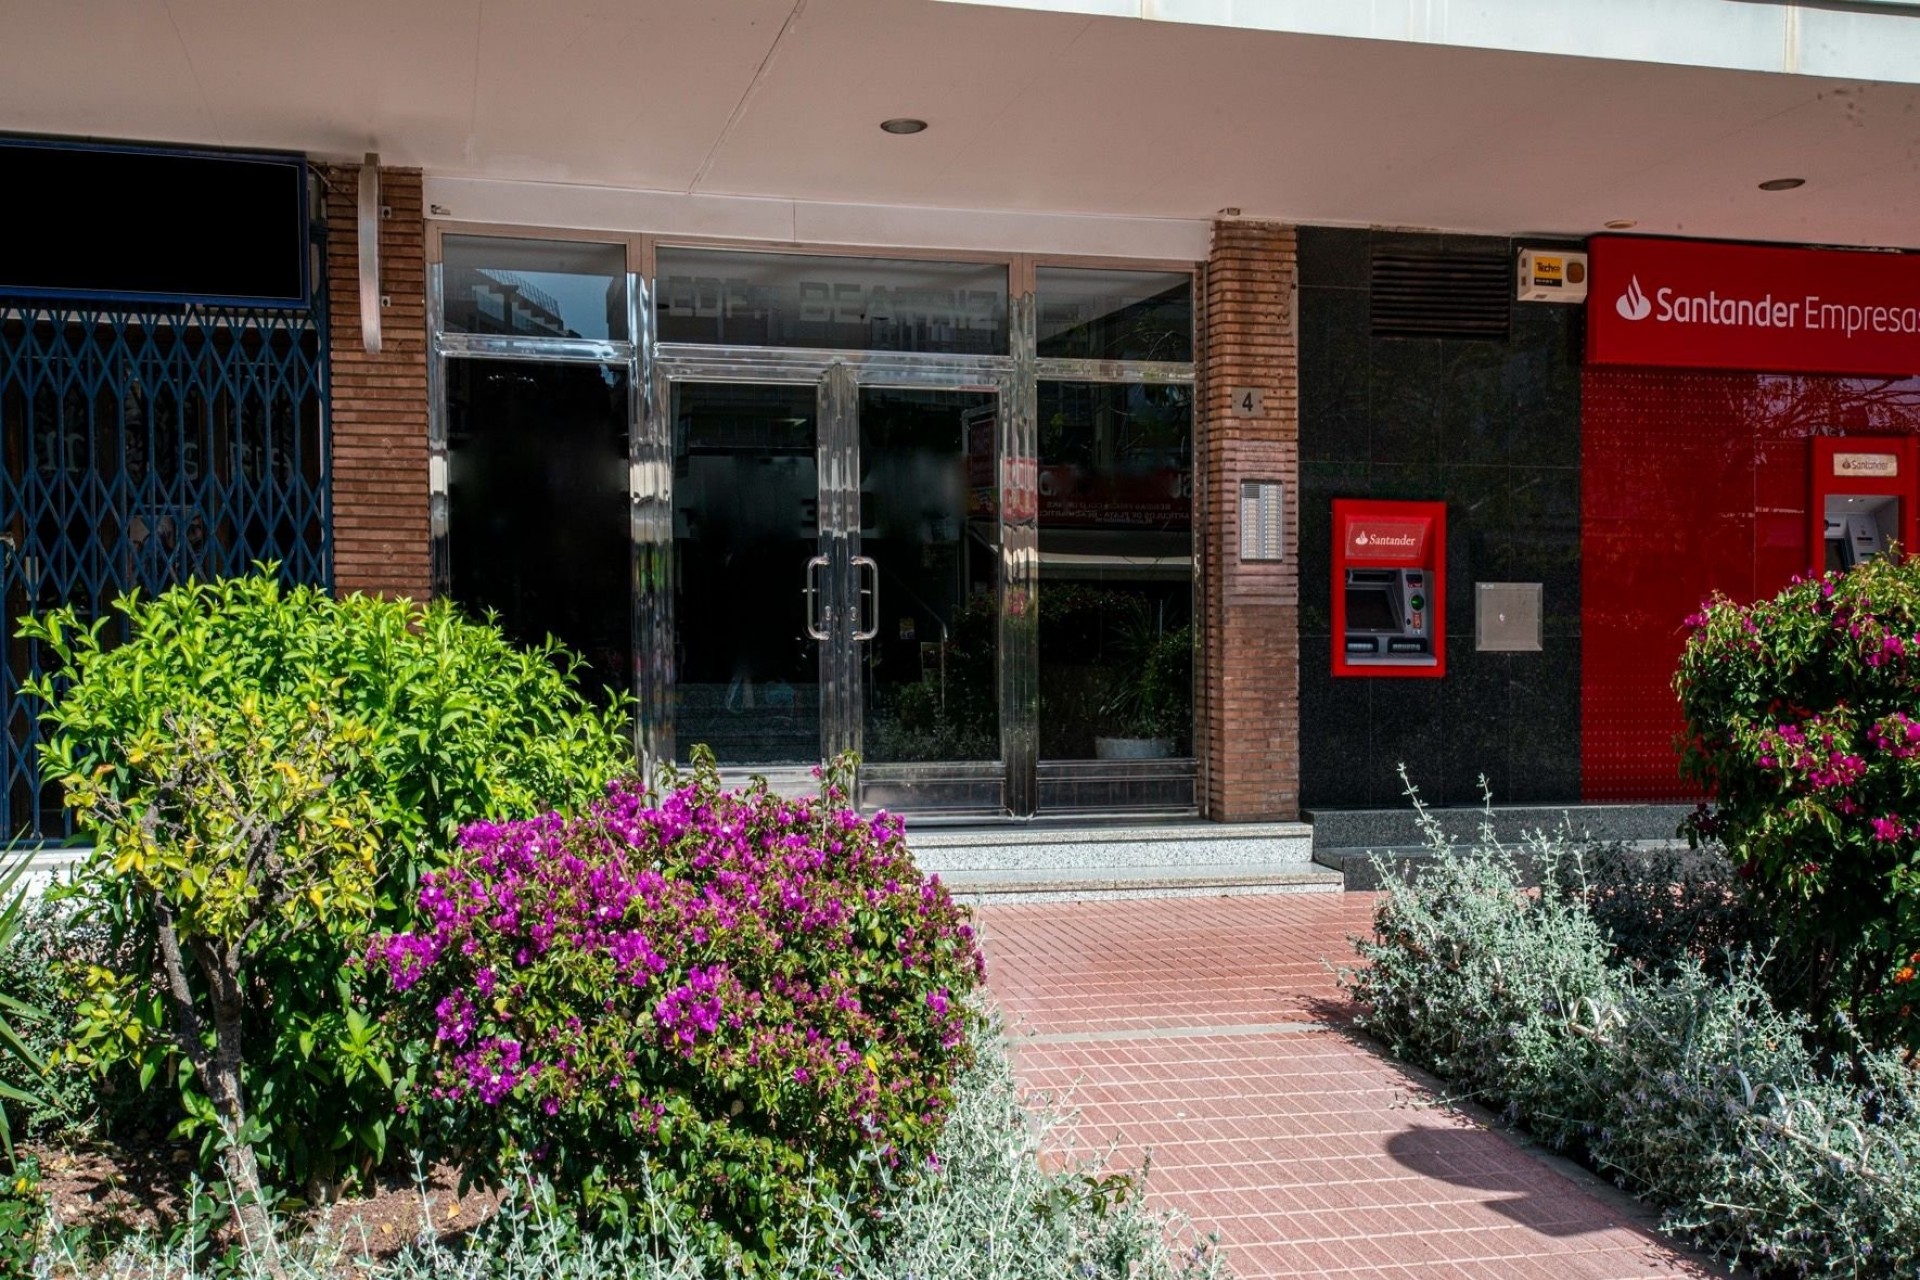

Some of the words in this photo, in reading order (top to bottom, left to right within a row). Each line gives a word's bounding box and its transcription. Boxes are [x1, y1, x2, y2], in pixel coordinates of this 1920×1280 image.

[799, 281, 999, 331] BEATRIZ
[1656, 287, 1800, 328] Santander
[1241, 391, 1254, 412] 4
[1851, 459, 1889, 471] Santander
[1369, 532, 1416, 547] Santander
